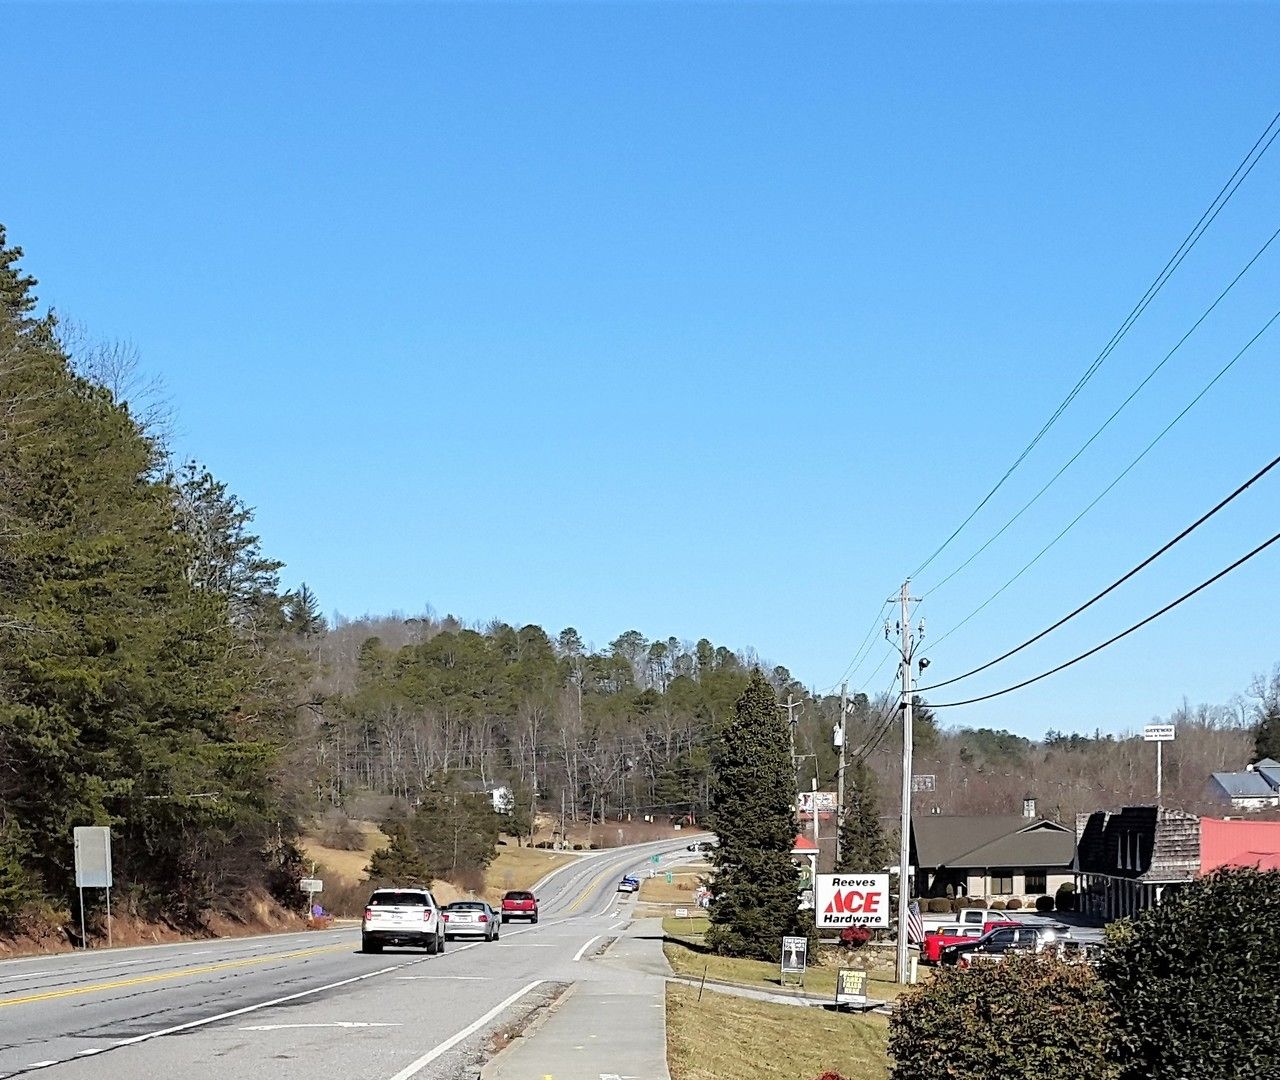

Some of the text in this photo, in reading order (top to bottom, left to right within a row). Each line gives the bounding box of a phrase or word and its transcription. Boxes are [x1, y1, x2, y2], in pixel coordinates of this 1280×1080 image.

[832, 877, 876, 887] Reeves
[823, 888, 882, 913] ACE
[823, 914, 882, 924] Hardware
